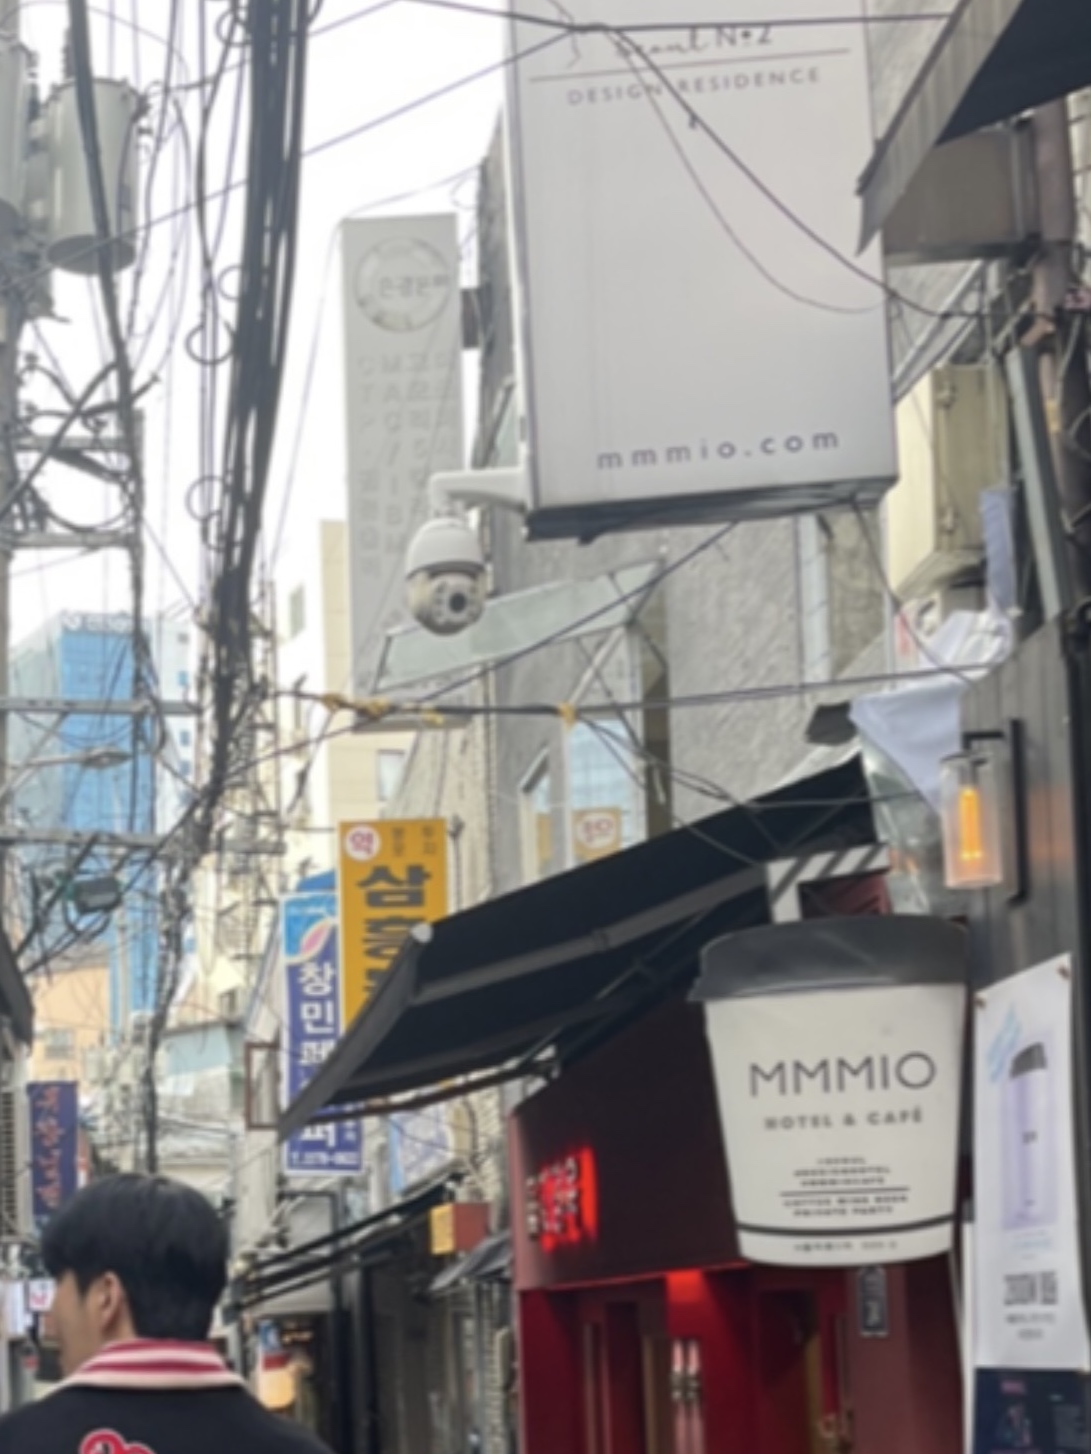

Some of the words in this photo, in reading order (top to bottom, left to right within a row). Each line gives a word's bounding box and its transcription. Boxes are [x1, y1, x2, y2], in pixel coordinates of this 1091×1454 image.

[566, 82, 662, 106] DESIGN
[677, 66, 821, 95] RESIDENCE
[597, 431, 839, 470] mmmio.com
[749, 1050, 937, 1098] MMMIO
[764, 1112, 833, 1130] HOTEL
[843, 1112, 856, 1127] &
[866, 1105, 923, 1126] CAFÉ
